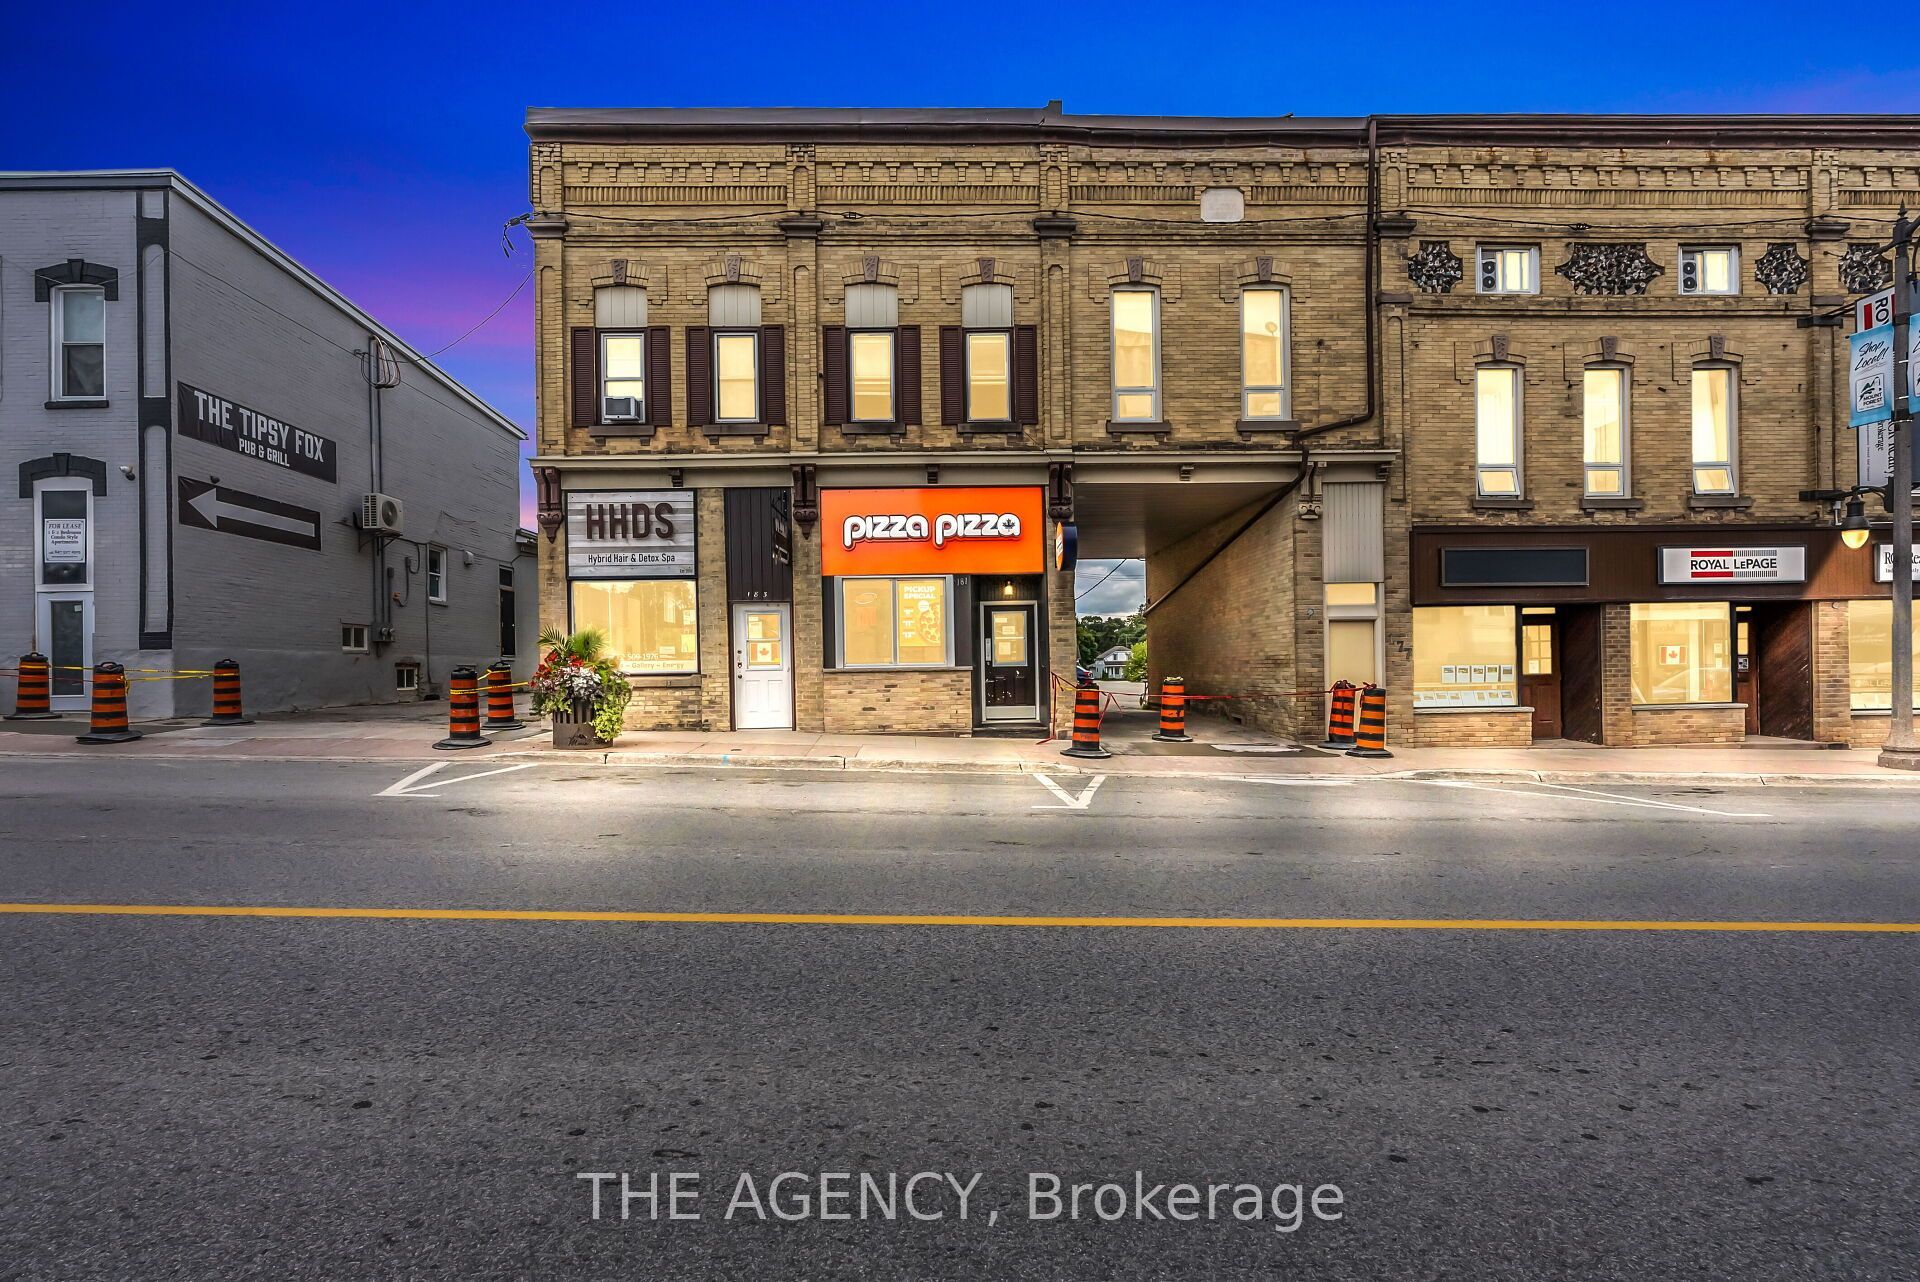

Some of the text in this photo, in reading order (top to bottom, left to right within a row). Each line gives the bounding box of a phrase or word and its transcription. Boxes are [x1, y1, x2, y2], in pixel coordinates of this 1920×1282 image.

[1858, 341, 1885, 357] Shop
[1854, 347, 1889, 371] Local!
[1863, 391, 1882, 401] MOUNT
[1863, 398, 1882, 406] FOREST
[194, 390, 324, 463] THE TIPSY FOX
[239, 438, 290, 467] PUB & GRILL
[586, 503, 674, 539] HHDS
[843, 513, 1021, 548] pizza pizza
[588, 553, 676, 565] Hybrid Hair & Detox Spa
[1690, 559, 1730, 570] ROYAL
[957, 577, 968, 586] 181
[904, 585, 936, 593] PICKUP
